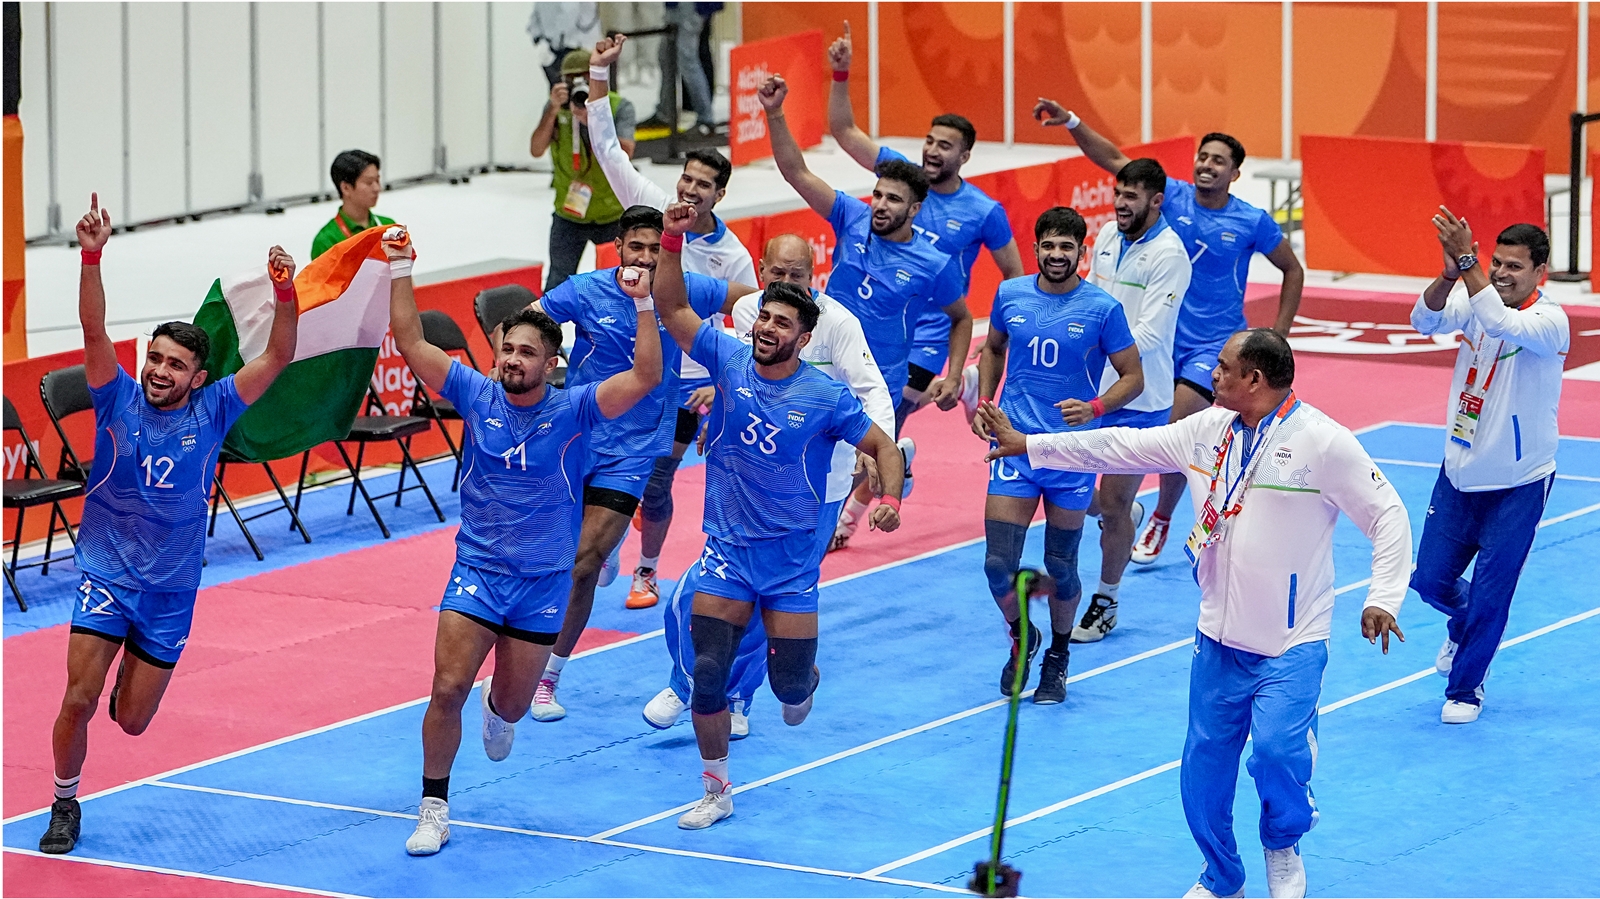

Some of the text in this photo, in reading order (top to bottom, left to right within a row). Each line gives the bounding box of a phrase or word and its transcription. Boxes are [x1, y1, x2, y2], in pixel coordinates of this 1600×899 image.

[1190, 239, 1208, 264] 7
[857, 274, 878, 300] 5
[1067, 326, 1084, 334] INDIA
[1027, 335, 1059, 368] 10
[787, 413, 805, 423] INDIA
[740, 412, 781, 455] 33
[501, 441, 527, 471] 11
[1274, 452, 1292, 460] INDIA
[140, 454, 175, 489] 12
[79, 579, 114, 616] 12
